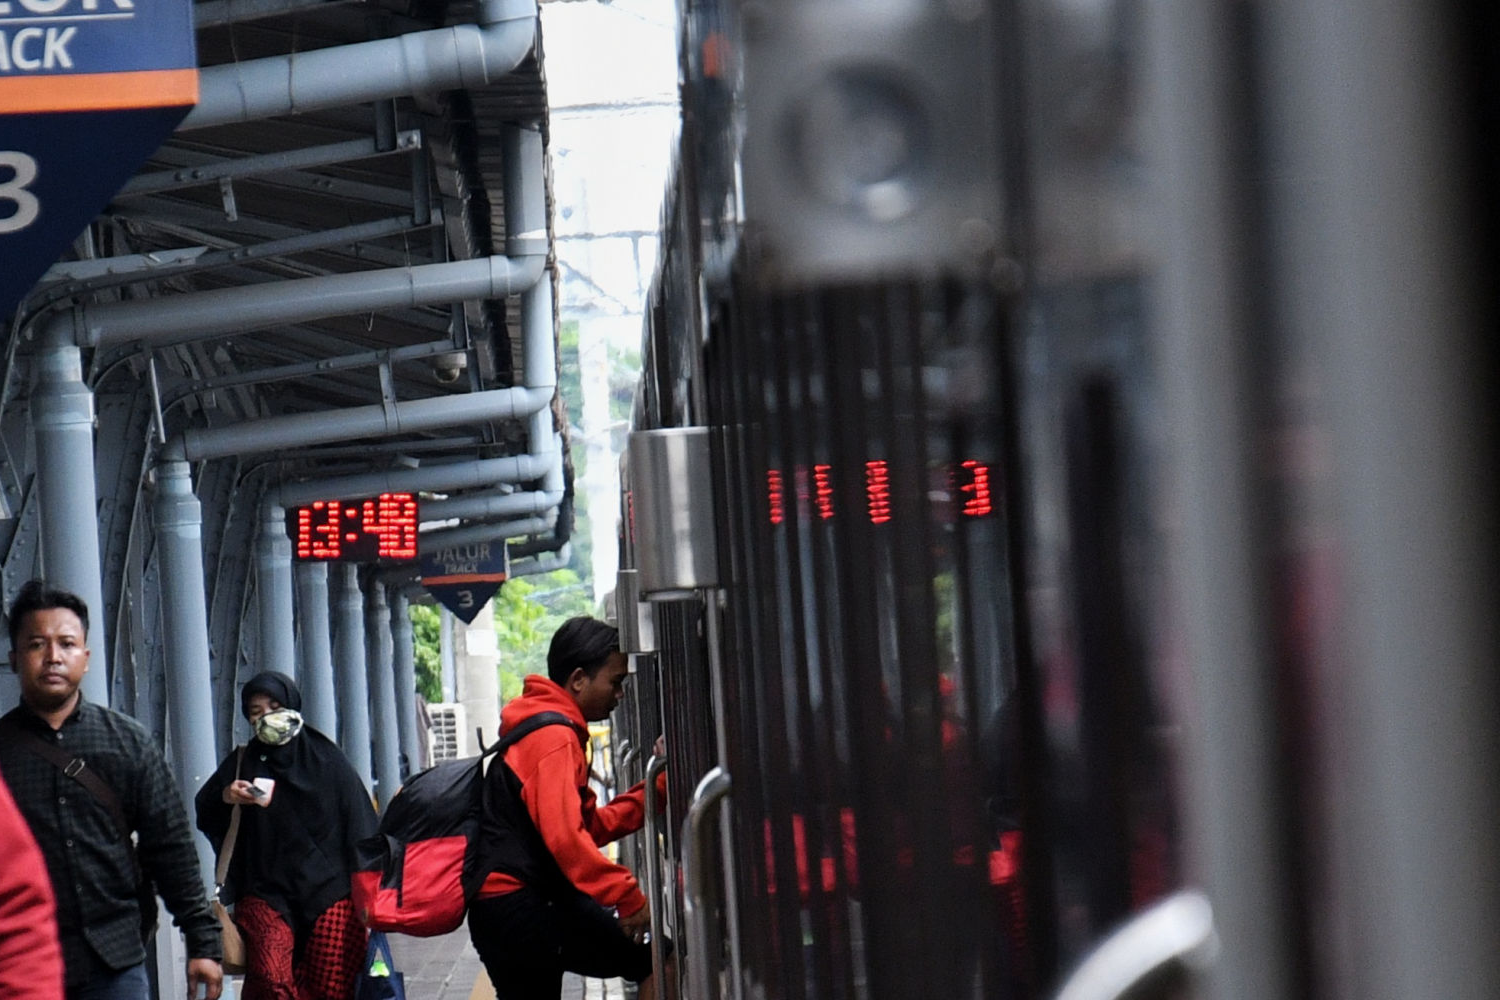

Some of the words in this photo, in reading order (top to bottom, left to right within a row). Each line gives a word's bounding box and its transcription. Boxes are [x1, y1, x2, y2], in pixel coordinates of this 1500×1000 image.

[298, 493, 417, 559] 13:48
[432, 543, 491, 564] JALUR
[444, 561, 478, 575] TRACK
[457, 590, 474, 608] 3
